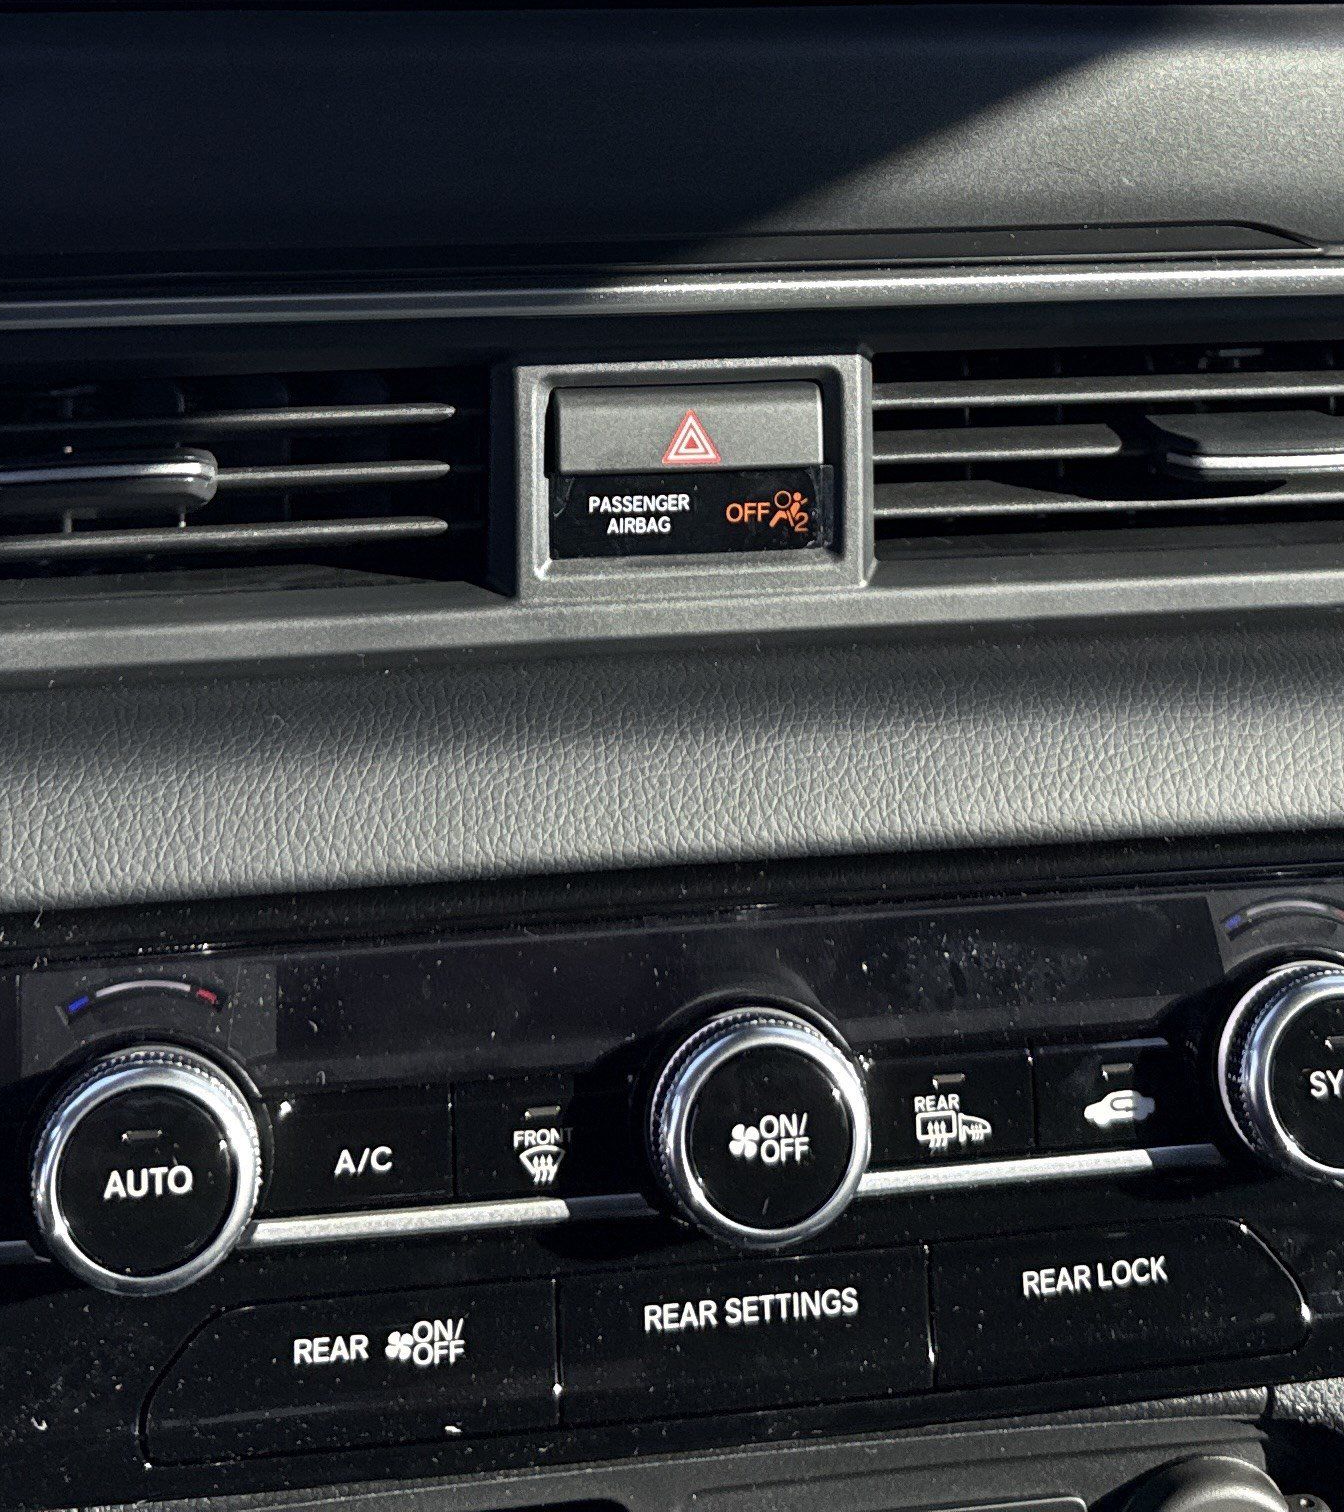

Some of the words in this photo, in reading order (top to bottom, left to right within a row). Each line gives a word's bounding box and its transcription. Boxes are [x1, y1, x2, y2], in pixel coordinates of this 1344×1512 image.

[588, 493, 691, 515] PASSENGER
[725, 501, 771, 524] OFF
[606, 515, 672, 535] AIRBAG
[913, 1093, 960, 1113] REAR
[513, 1126, 574, 1149] FRONT
[759, 1113, 809, 1138] ON/
[333, 1145, 394, 1177] A/C
[760, 1137, 811, 1164] OFF
[102, 1165, 195, 1200] AUTO
[1022, 1263, 1092, 1298] REAR
[1097, 1255, 1168, 1290] LOCK
[644, 1300, 718, 1333] REAR
[724, 1287, 859, 1325] SETTINGS
[411, 1318, 465, 1343] ON/
[293, 1334, 370, 1366] REAR
[412, 1341, 466, 1366] OFF
